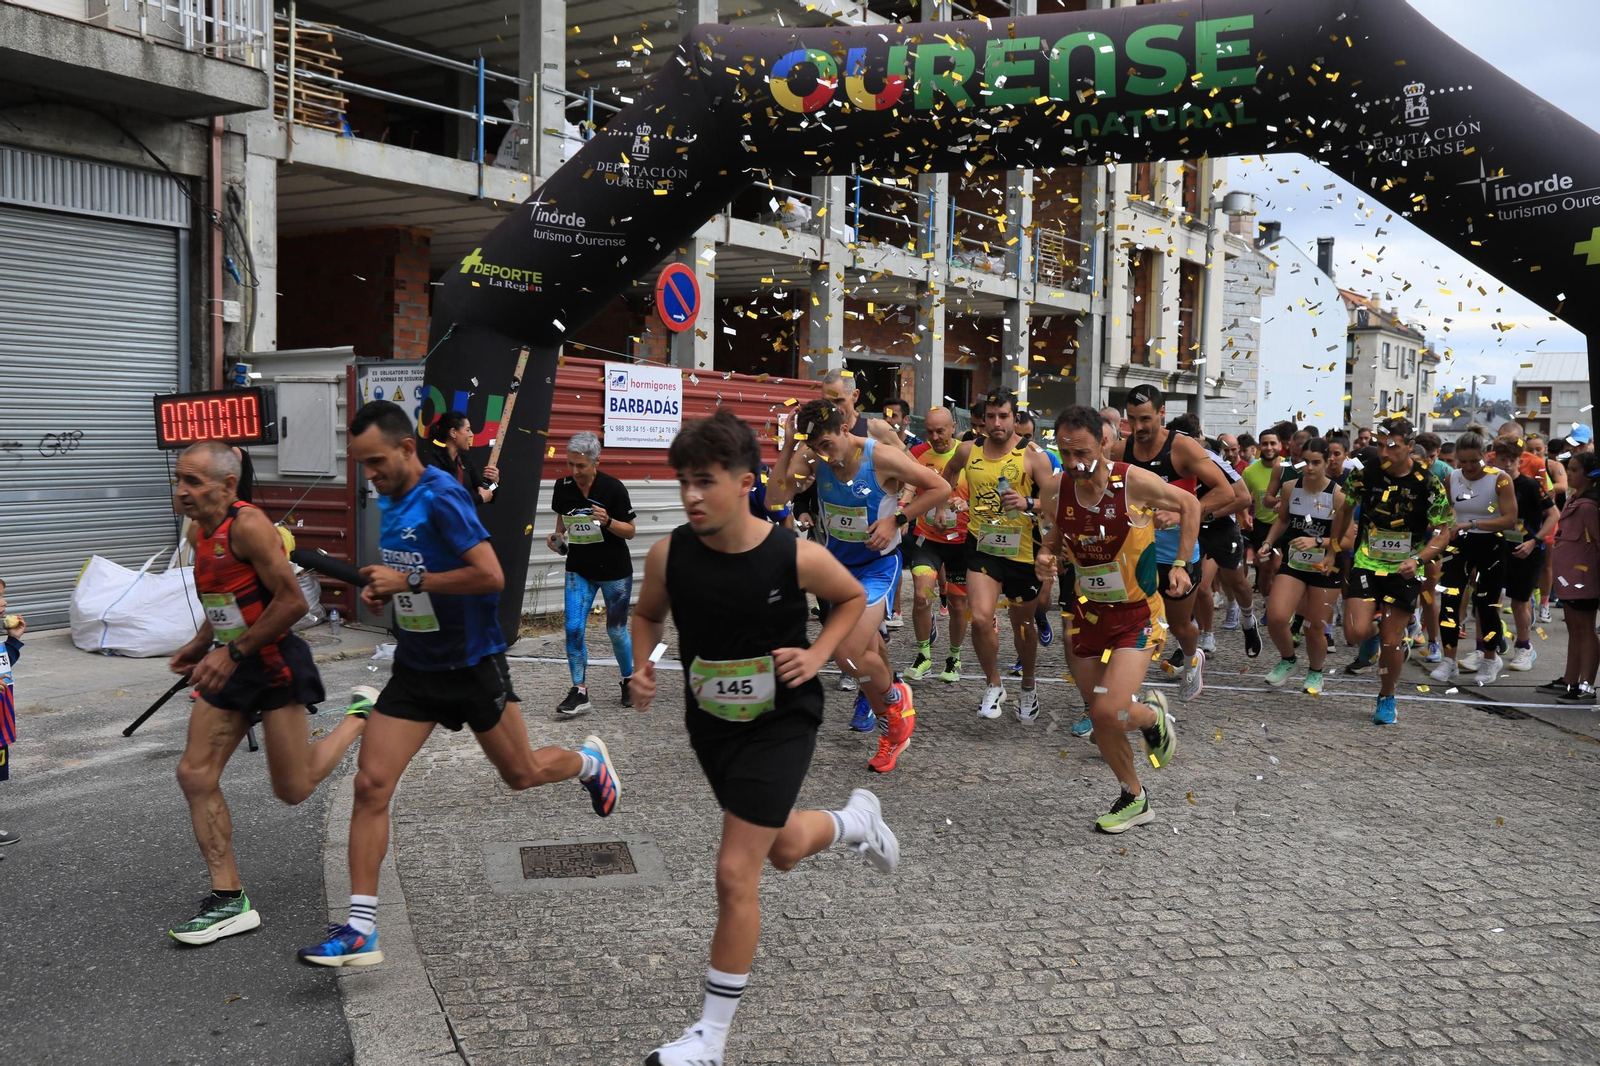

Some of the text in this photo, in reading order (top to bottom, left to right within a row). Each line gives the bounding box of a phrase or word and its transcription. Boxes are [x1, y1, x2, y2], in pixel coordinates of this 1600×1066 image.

[768, 14, 1256, 114] OURENSE
[1360, 121, 1481, 151] DEPUTACIÓN
[1377, 140, 1466, 163] OURENSE
[597, 162, 688, 179] DEPUTACIÓN
[1494, 173, 1573, 201] inorde
[536, 208, 586, 228] inorde
[1497, 203, 1557, 221] turismo
[533, 228, 626, 247] turismo Ourense
[488, 277, 503, 287] La
[630, 378, 677, 392] hormigones
[609, 395, 679, 415] BARBADÁS
[161, 396, 259, 441] 00:00:00
[574, 524, 591, 532] 210
[840, 516, 853, 526] 67
[995, 534, 1007, 543] 31
[1381, 540, 1401, 549] 194
[1301, 552, 1313, 560] 97
[1088, 577, 1105, 587] 78
[716, 679, 753, 695] 145
